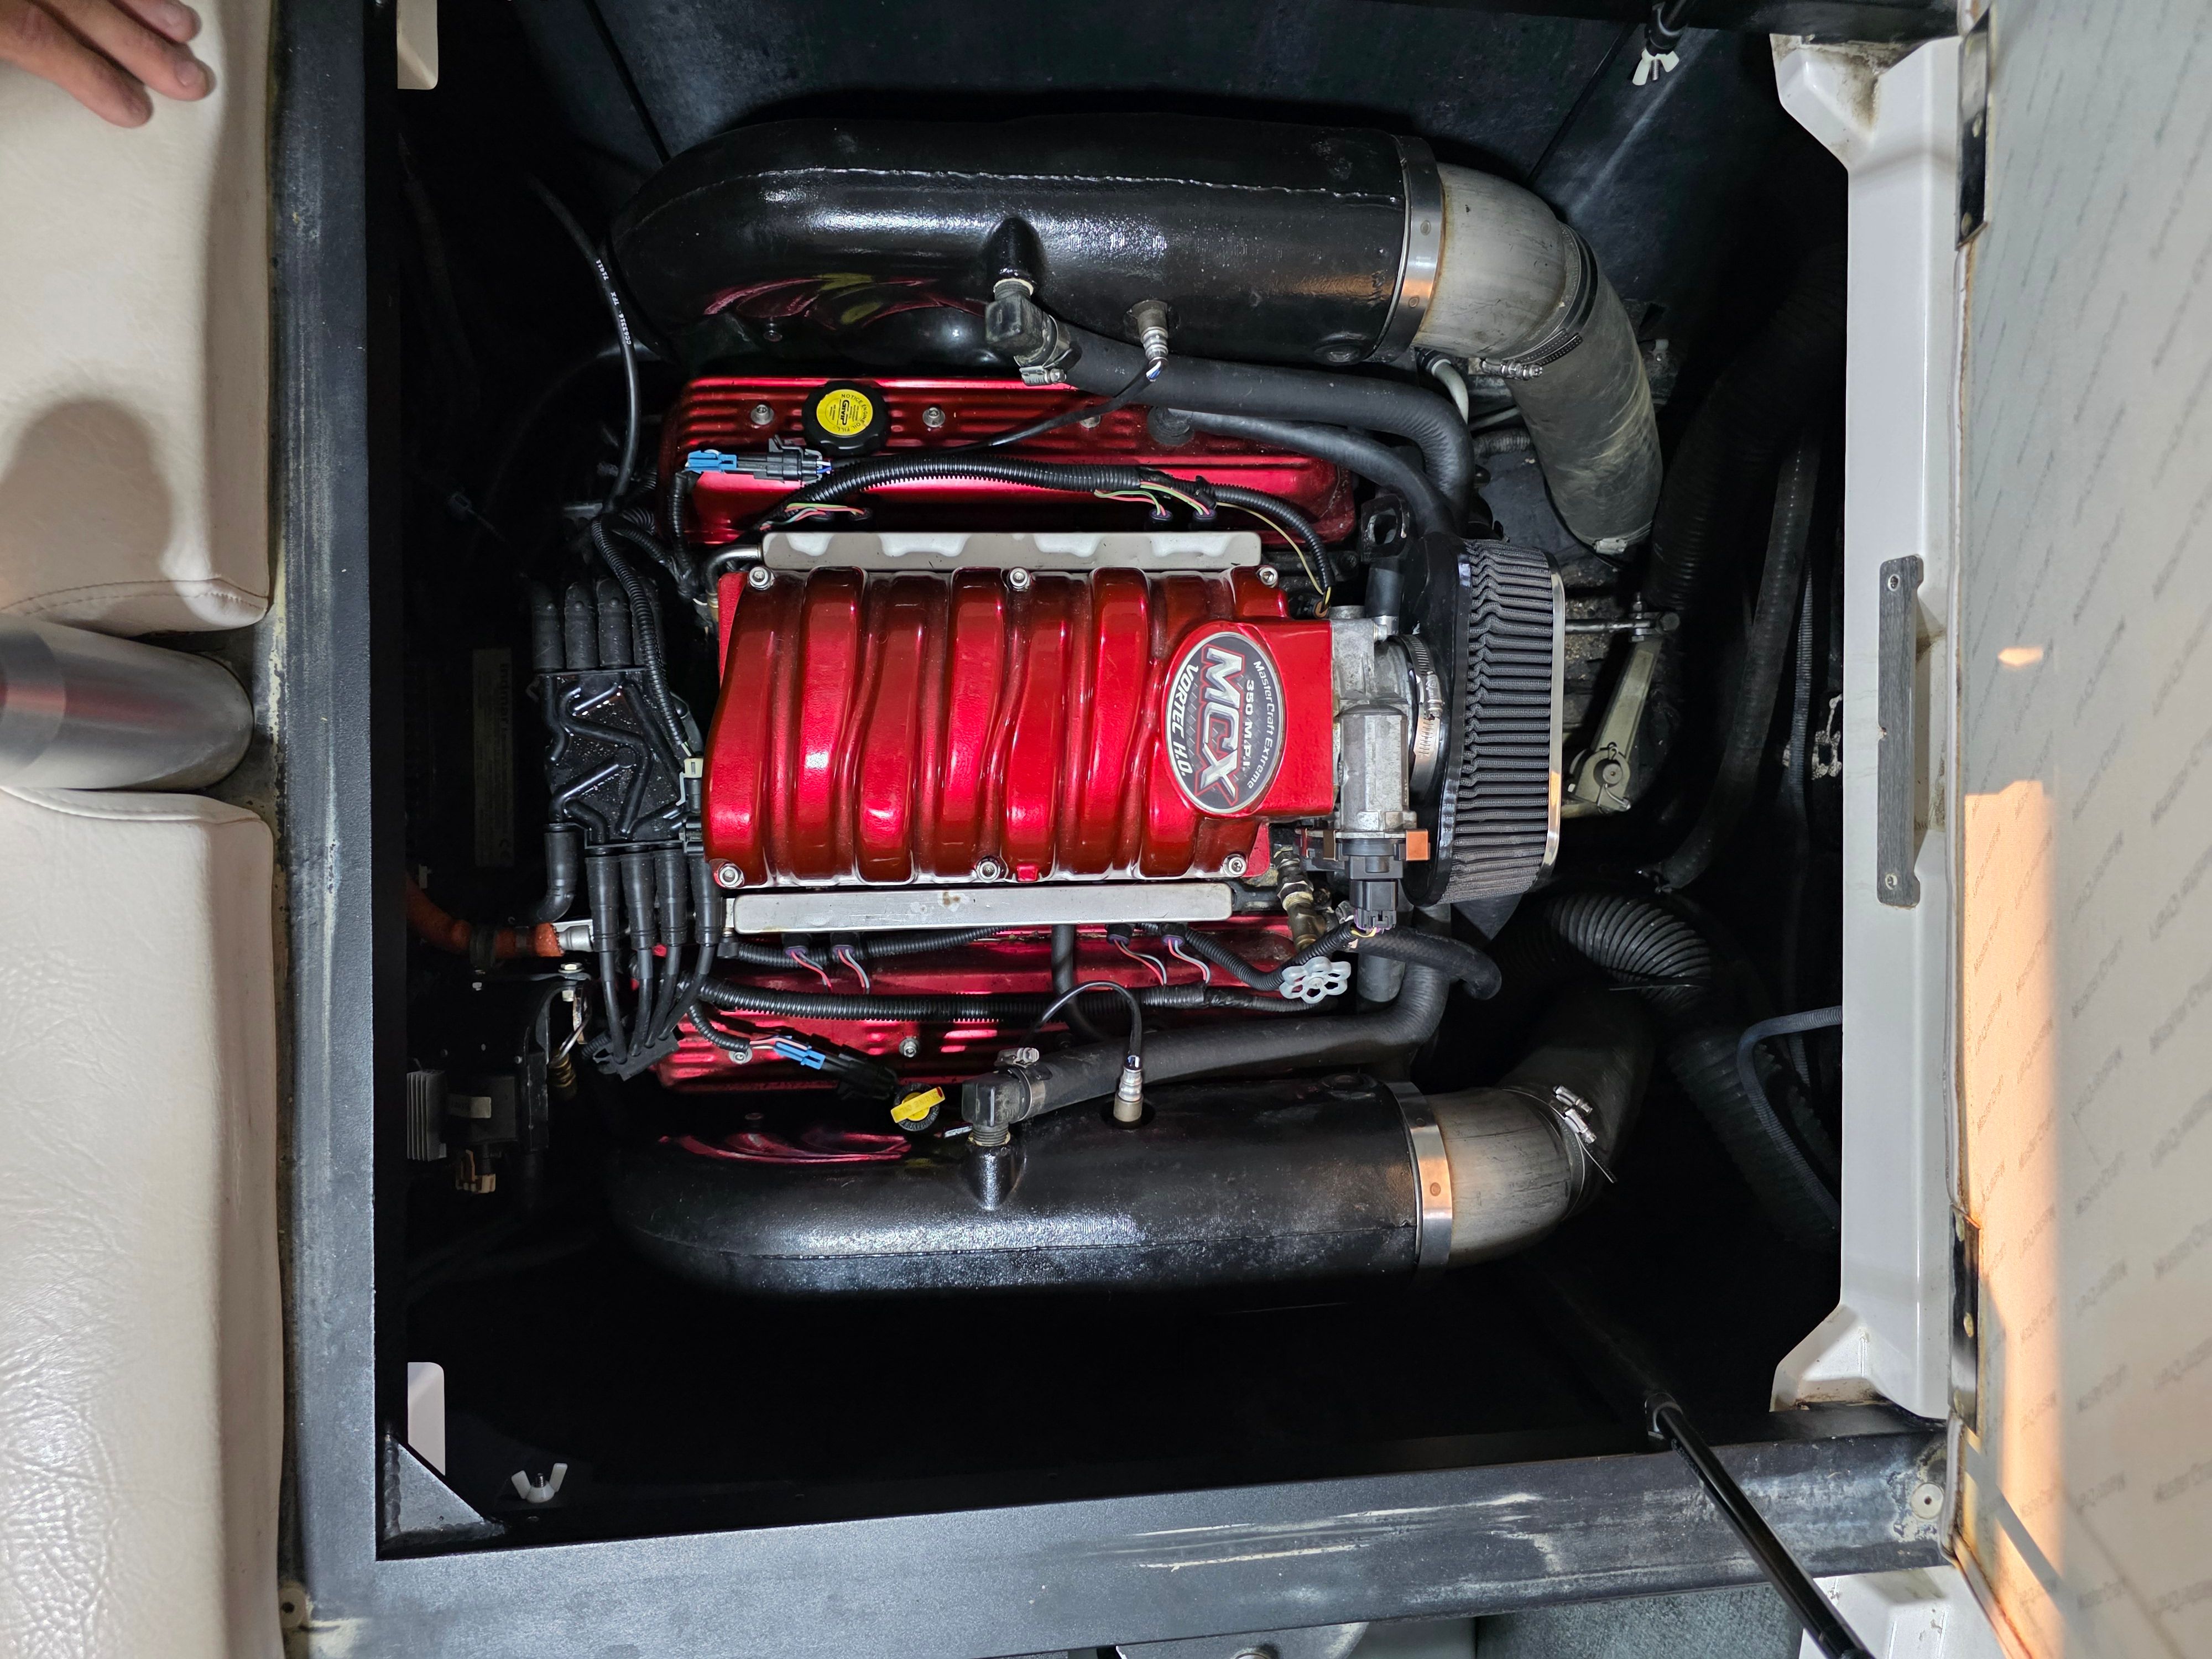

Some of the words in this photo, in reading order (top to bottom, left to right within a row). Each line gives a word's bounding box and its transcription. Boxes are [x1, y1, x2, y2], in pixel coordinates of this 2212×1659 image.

[610, 291, 619, 305] TFX
[841, 394, 863, 404] NOTICE
[860, 404, 868, 424] ENGINE
[1172, 664, 1199, 740] VORTEC
[1200, 648, 1242, 797] MCX
[1245, 680, 1255, 716] 350
[1253, 661, 1275, 735] MasterCraft
[1173, 742, 1193, 776] H.O.
[1242, 721, 1254, 772] M.P.I.
[1246, 737, 1274, 789] Extreme
